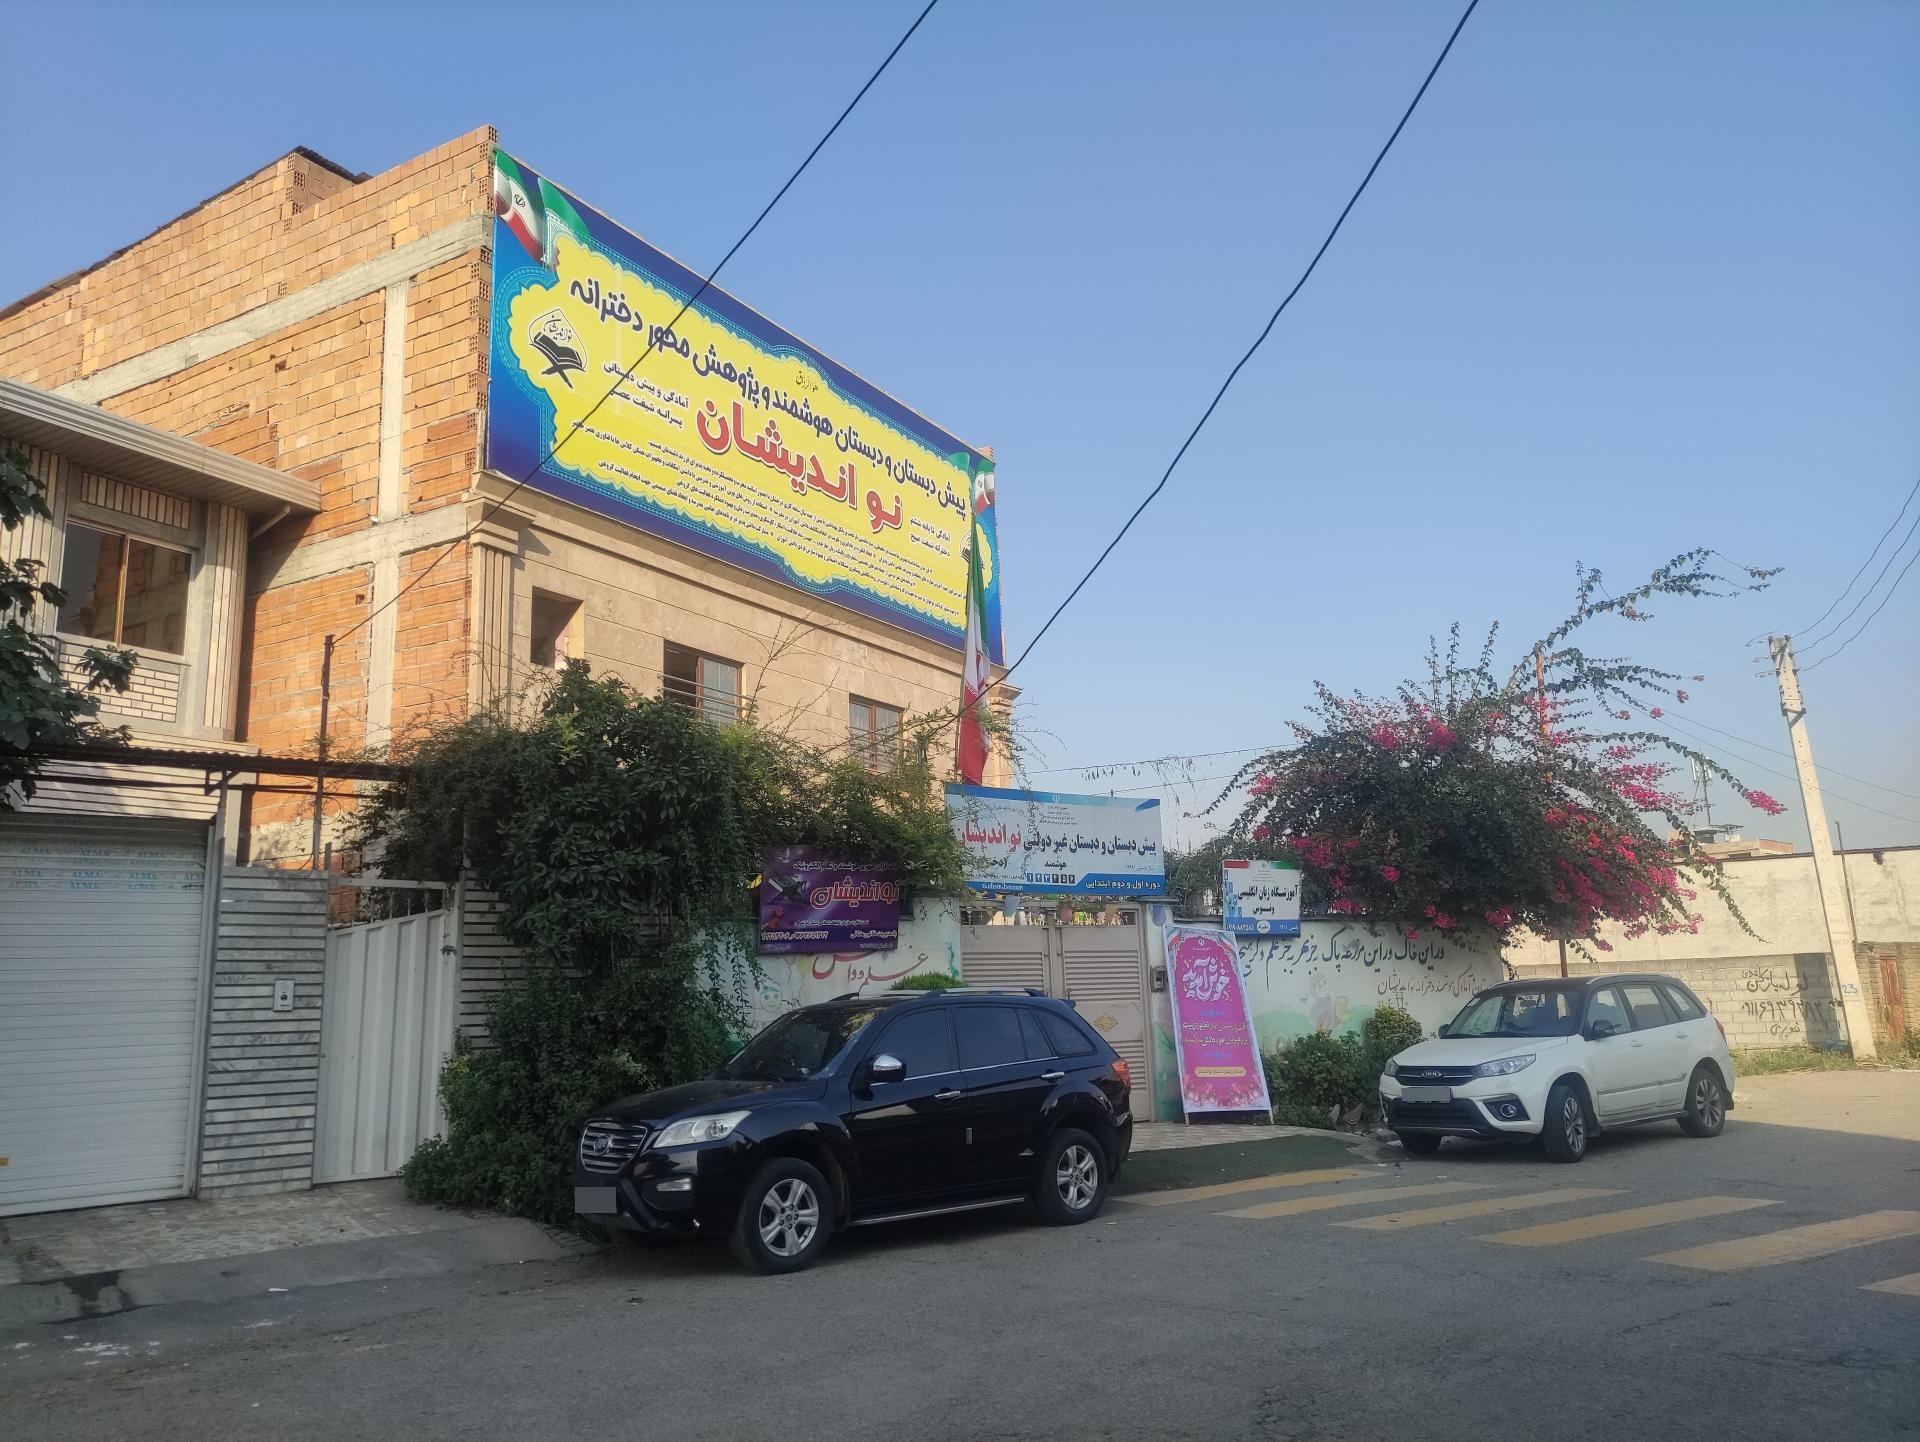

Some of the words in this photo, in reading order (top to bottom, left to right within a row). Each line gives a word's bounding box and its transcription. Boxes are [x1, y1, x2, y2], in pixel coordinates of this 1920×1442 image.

[570, 278, 643, 332] دخترانه
[647, 324, 690, 358] محور
[603, 363, 635, 382] دبستانی
[692, 343, 760, 409] پژوهش
[637, 379, 655, 395] پیش
[657, 389, 661, 398] و
[632, 398, 655, 412] شیفت
[663, 392, 689, 408] آمادگی
[761, 386, 770, 411] و
[656, 408, 683, 429] پسرانه
[772, 390, 833, 439] هوشمند
[697, 402, 856, 505] اندیشان
[834, 425, 884, 468] دبستان
[884, 455, 892, 478] و
[893, 458, 937, 498] دبستان
[866, 492, 902, 529] نو
[937, 481, 966, 522] پیش
[1009, 824, 1022, 852] نو
[1024, 831, 1052, 852] دولتی
[1054, 832, 1068, 853] غیر
[1069, 834, 1100, 854] دبستان
[1107, 836, 1136, 855] دبستان
[1138, 837, 1156, 856] پیش
[1101, 844, 1106, 855] و
[1044, 860, 1067, 870] هوشمند
[1086, 879, 1110, 888] ابتدایی
[1132, 881, 1143, 889] اول
[1238, 886, 1258, 900] انگلیسی
[1259, 886, 1269, 900] زبان
[1271, 885, 1298, 900] آموزشگاه
